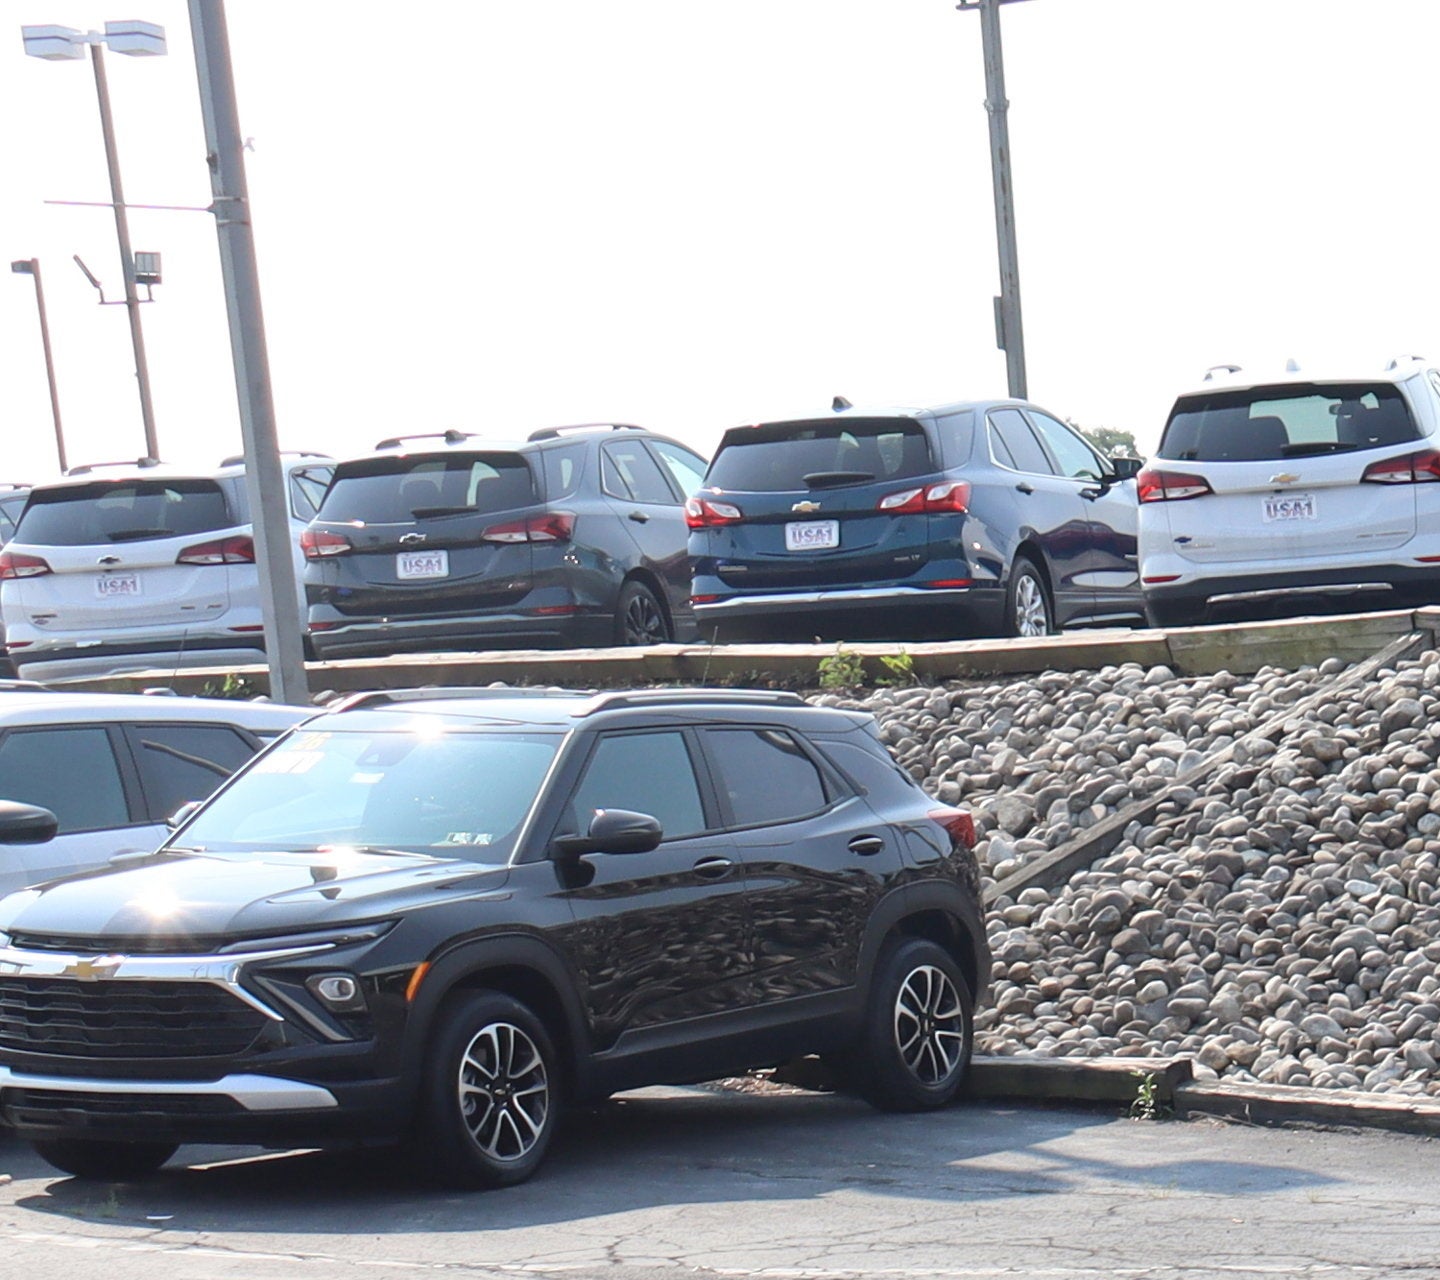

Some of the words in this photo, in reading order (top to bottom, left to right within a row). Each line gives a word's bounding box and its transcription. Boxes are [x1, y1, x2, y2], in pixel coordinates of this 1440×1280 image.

[1265, 501, 1313, 519] USA1
[792, 527, 833, 544] USA1
[402, 558, 443, 573] USA1
[98, 579, 138, 594] USA1
